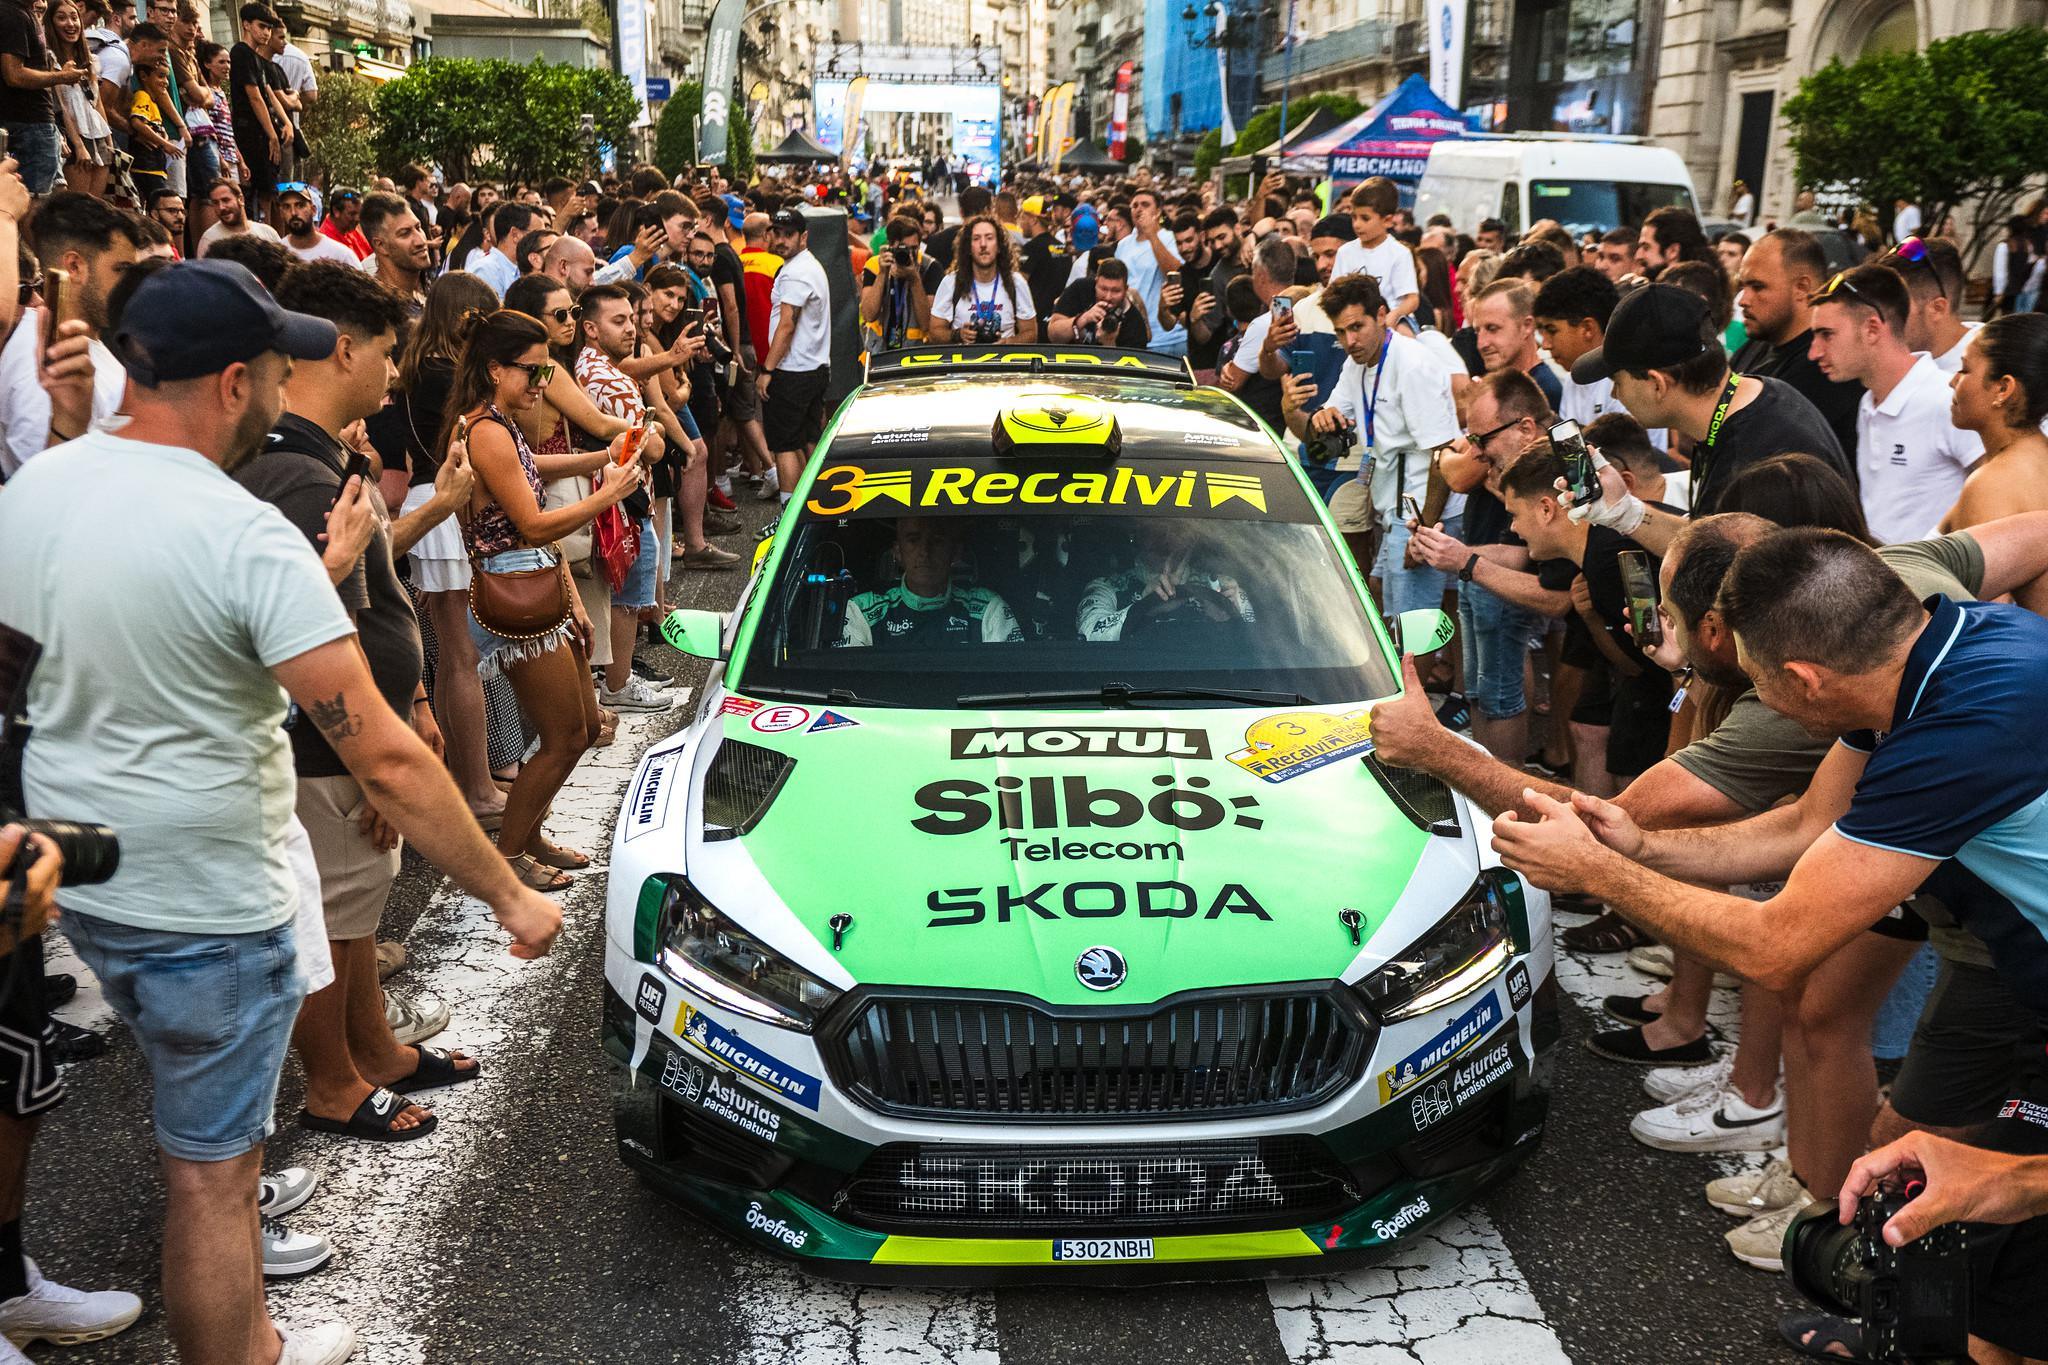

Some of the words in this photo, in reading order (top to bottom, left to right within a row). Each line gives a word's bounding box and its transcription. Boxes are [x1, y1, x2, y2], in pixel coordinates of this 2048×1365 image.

[807, 465, 867, 515] 3
[919, 467, 1198, 508] Recalvi
[663, 614, 686, 645] RACC
[962, 731, 1199, 753] MOTUL
[1276, 721, 1307, 736] 3
[1267, 741, 1332, 769] Recalvi
[638, 767, 663, 824] MICHELIN
[910, 774, 1226, 836] Silbö
[1000, 837, 1185, 862] Telecom
[926, 880, 1274, 928] SKODA
[641, 981, 664, 1003] UFI
[1509, 970, 1528, 993] UFI
[1513, 984, 1531, 1004] FILTERS
[638, 997, 659, 1017] FILTERS
[1420, 1006, 1492, 1072] MICHELIN
[709, 1036, 806, 1095] MICHELIN
[1453, 1042, 1509, 1092] Asturias
[1456, 1078, 1487, 1106] paraíso
[1486, 1057, 1515, 1084] natural
[702, 1096, 740, 1123] paraíso
[739, 1114, 778, 1143] natural
[707, 1075, 781, 1129] Asturias
[899, 1157, 1283, 1214] SKODA
[1063, 1240, 1150, 1258] 5302NBH
